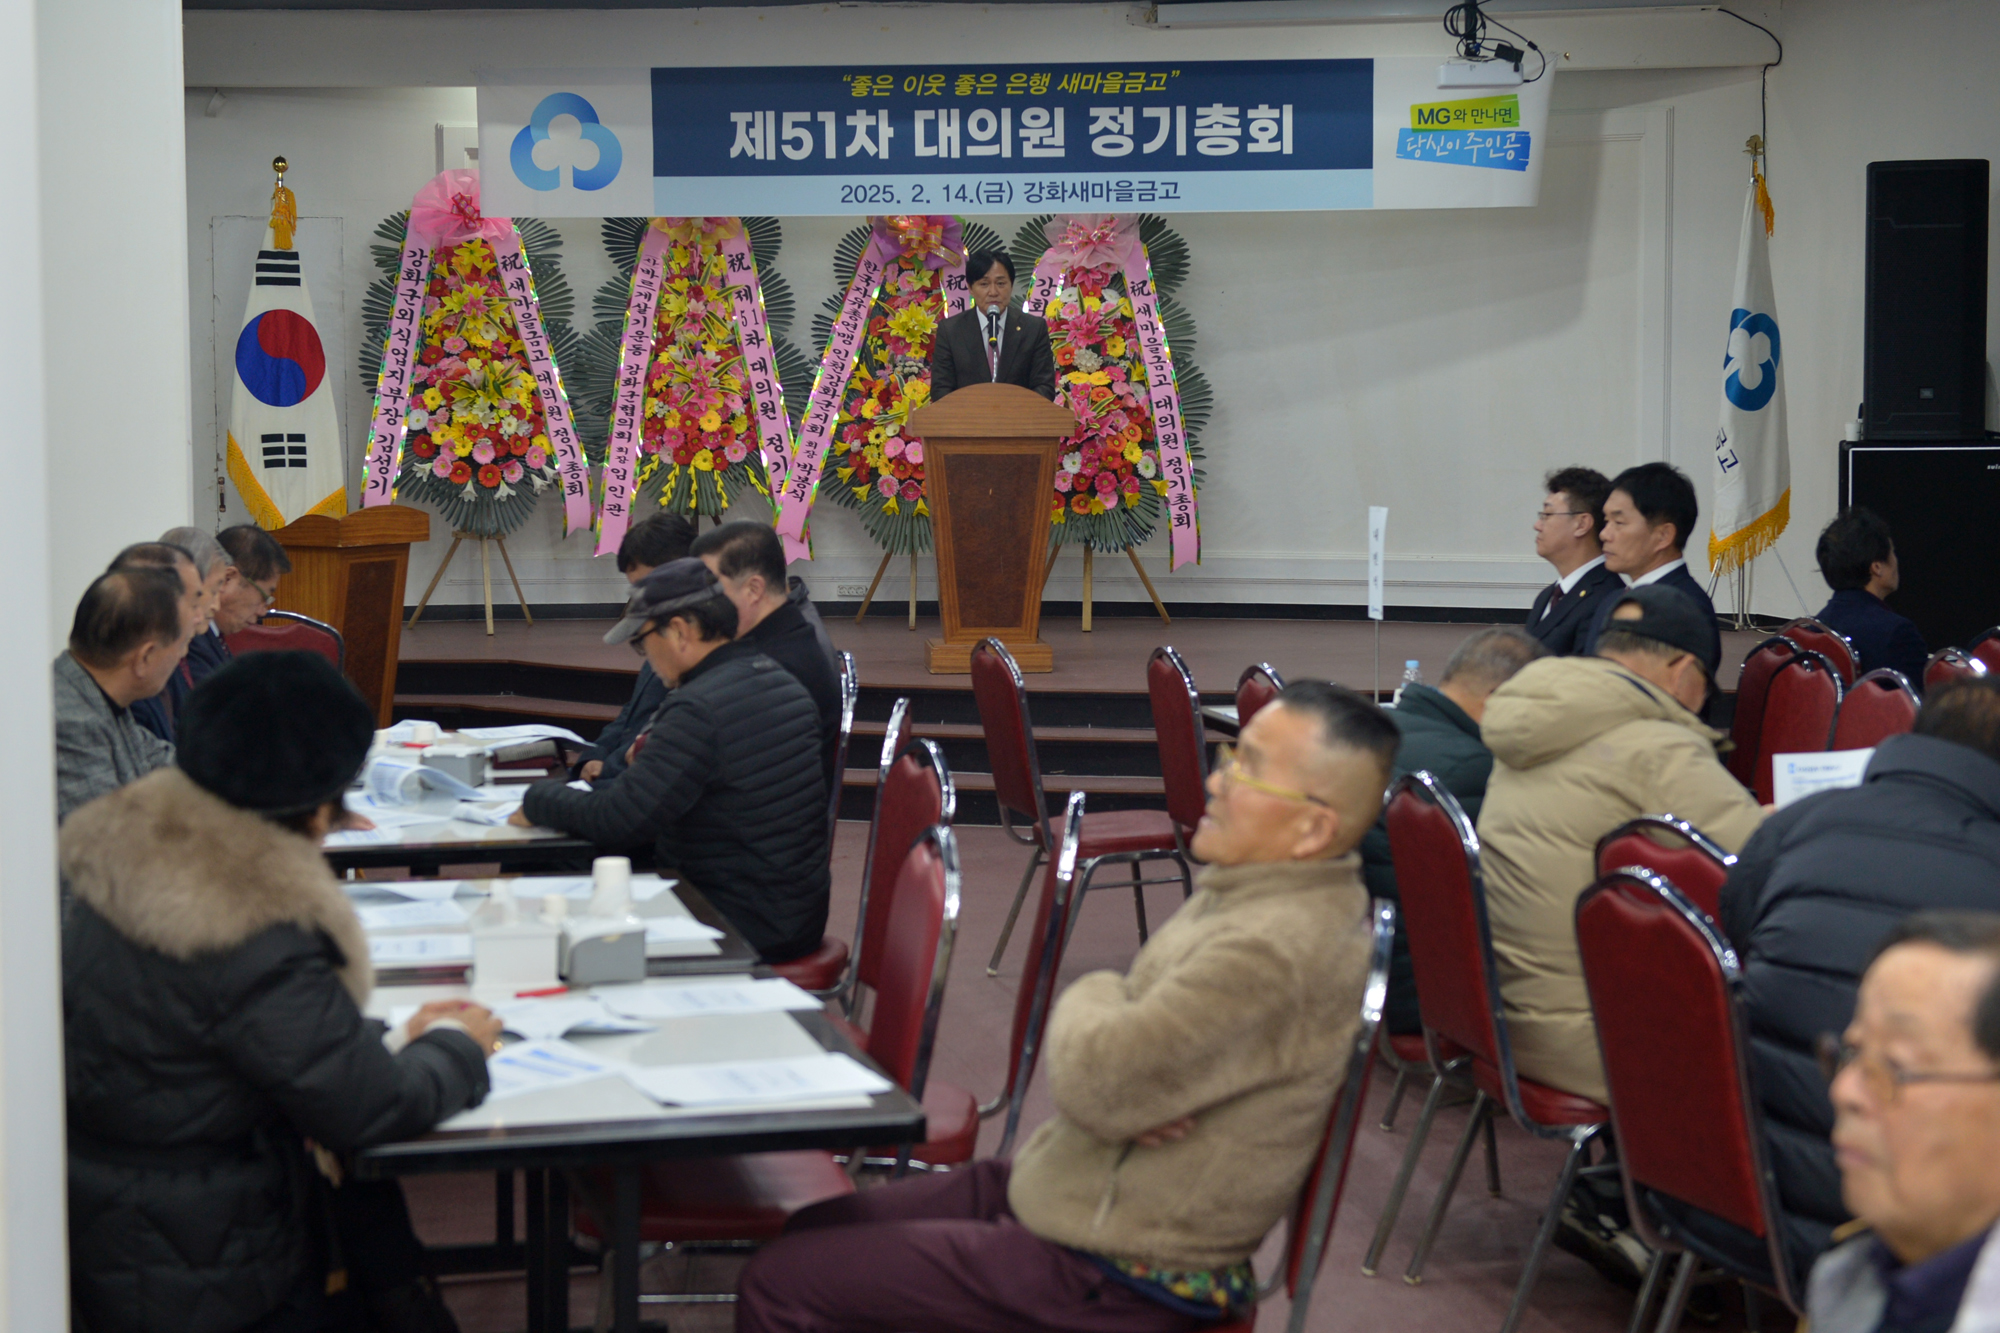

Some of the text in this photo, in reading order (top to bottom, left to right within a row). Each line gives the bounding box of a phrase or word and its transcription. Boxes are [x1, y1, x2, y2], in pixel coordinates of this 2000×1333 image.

[903, 74, 946, 95] 이웃
[954, 73, 998, 95] 좋은
[1006, 72, 1050, 95] 은행
[1057, 70, 1180, 94] 새마을금고”
[730, 104, 1293, 160] 제51차 대의원 정기총회
[1417, 107, 1512, 125] MG와 만나면
[1406, 132, 1521, 164] 당신이 주인공
[841, 184, 900, 204] 2025.
[911, 184, 930, 203] 2.
[1023, 180, 1181, 203] 강화새마을금고
[728, 252, 751, 272] 祝
[946, 274, 968, 291] 祝
[735, 284, 765, 349] 제51차
[837, 259, 880, 346] 한국자유총연맹
[500, 252, 584, 497] 祝 새마을금고 대의원 정기총회
[750, 356, 777, 420] 대의원
[805, 348, 850, 437] 인천강화군지회
[614, 363, 643, 443] 강화군협의회
[1130, 280, 1191, 529] 祝 새마을금고 대의원 정기총회
[369, 433, 395, 496] 김성기
[615, 446, 629, 464] 회장
[803, 440, 818, 459] 회장
